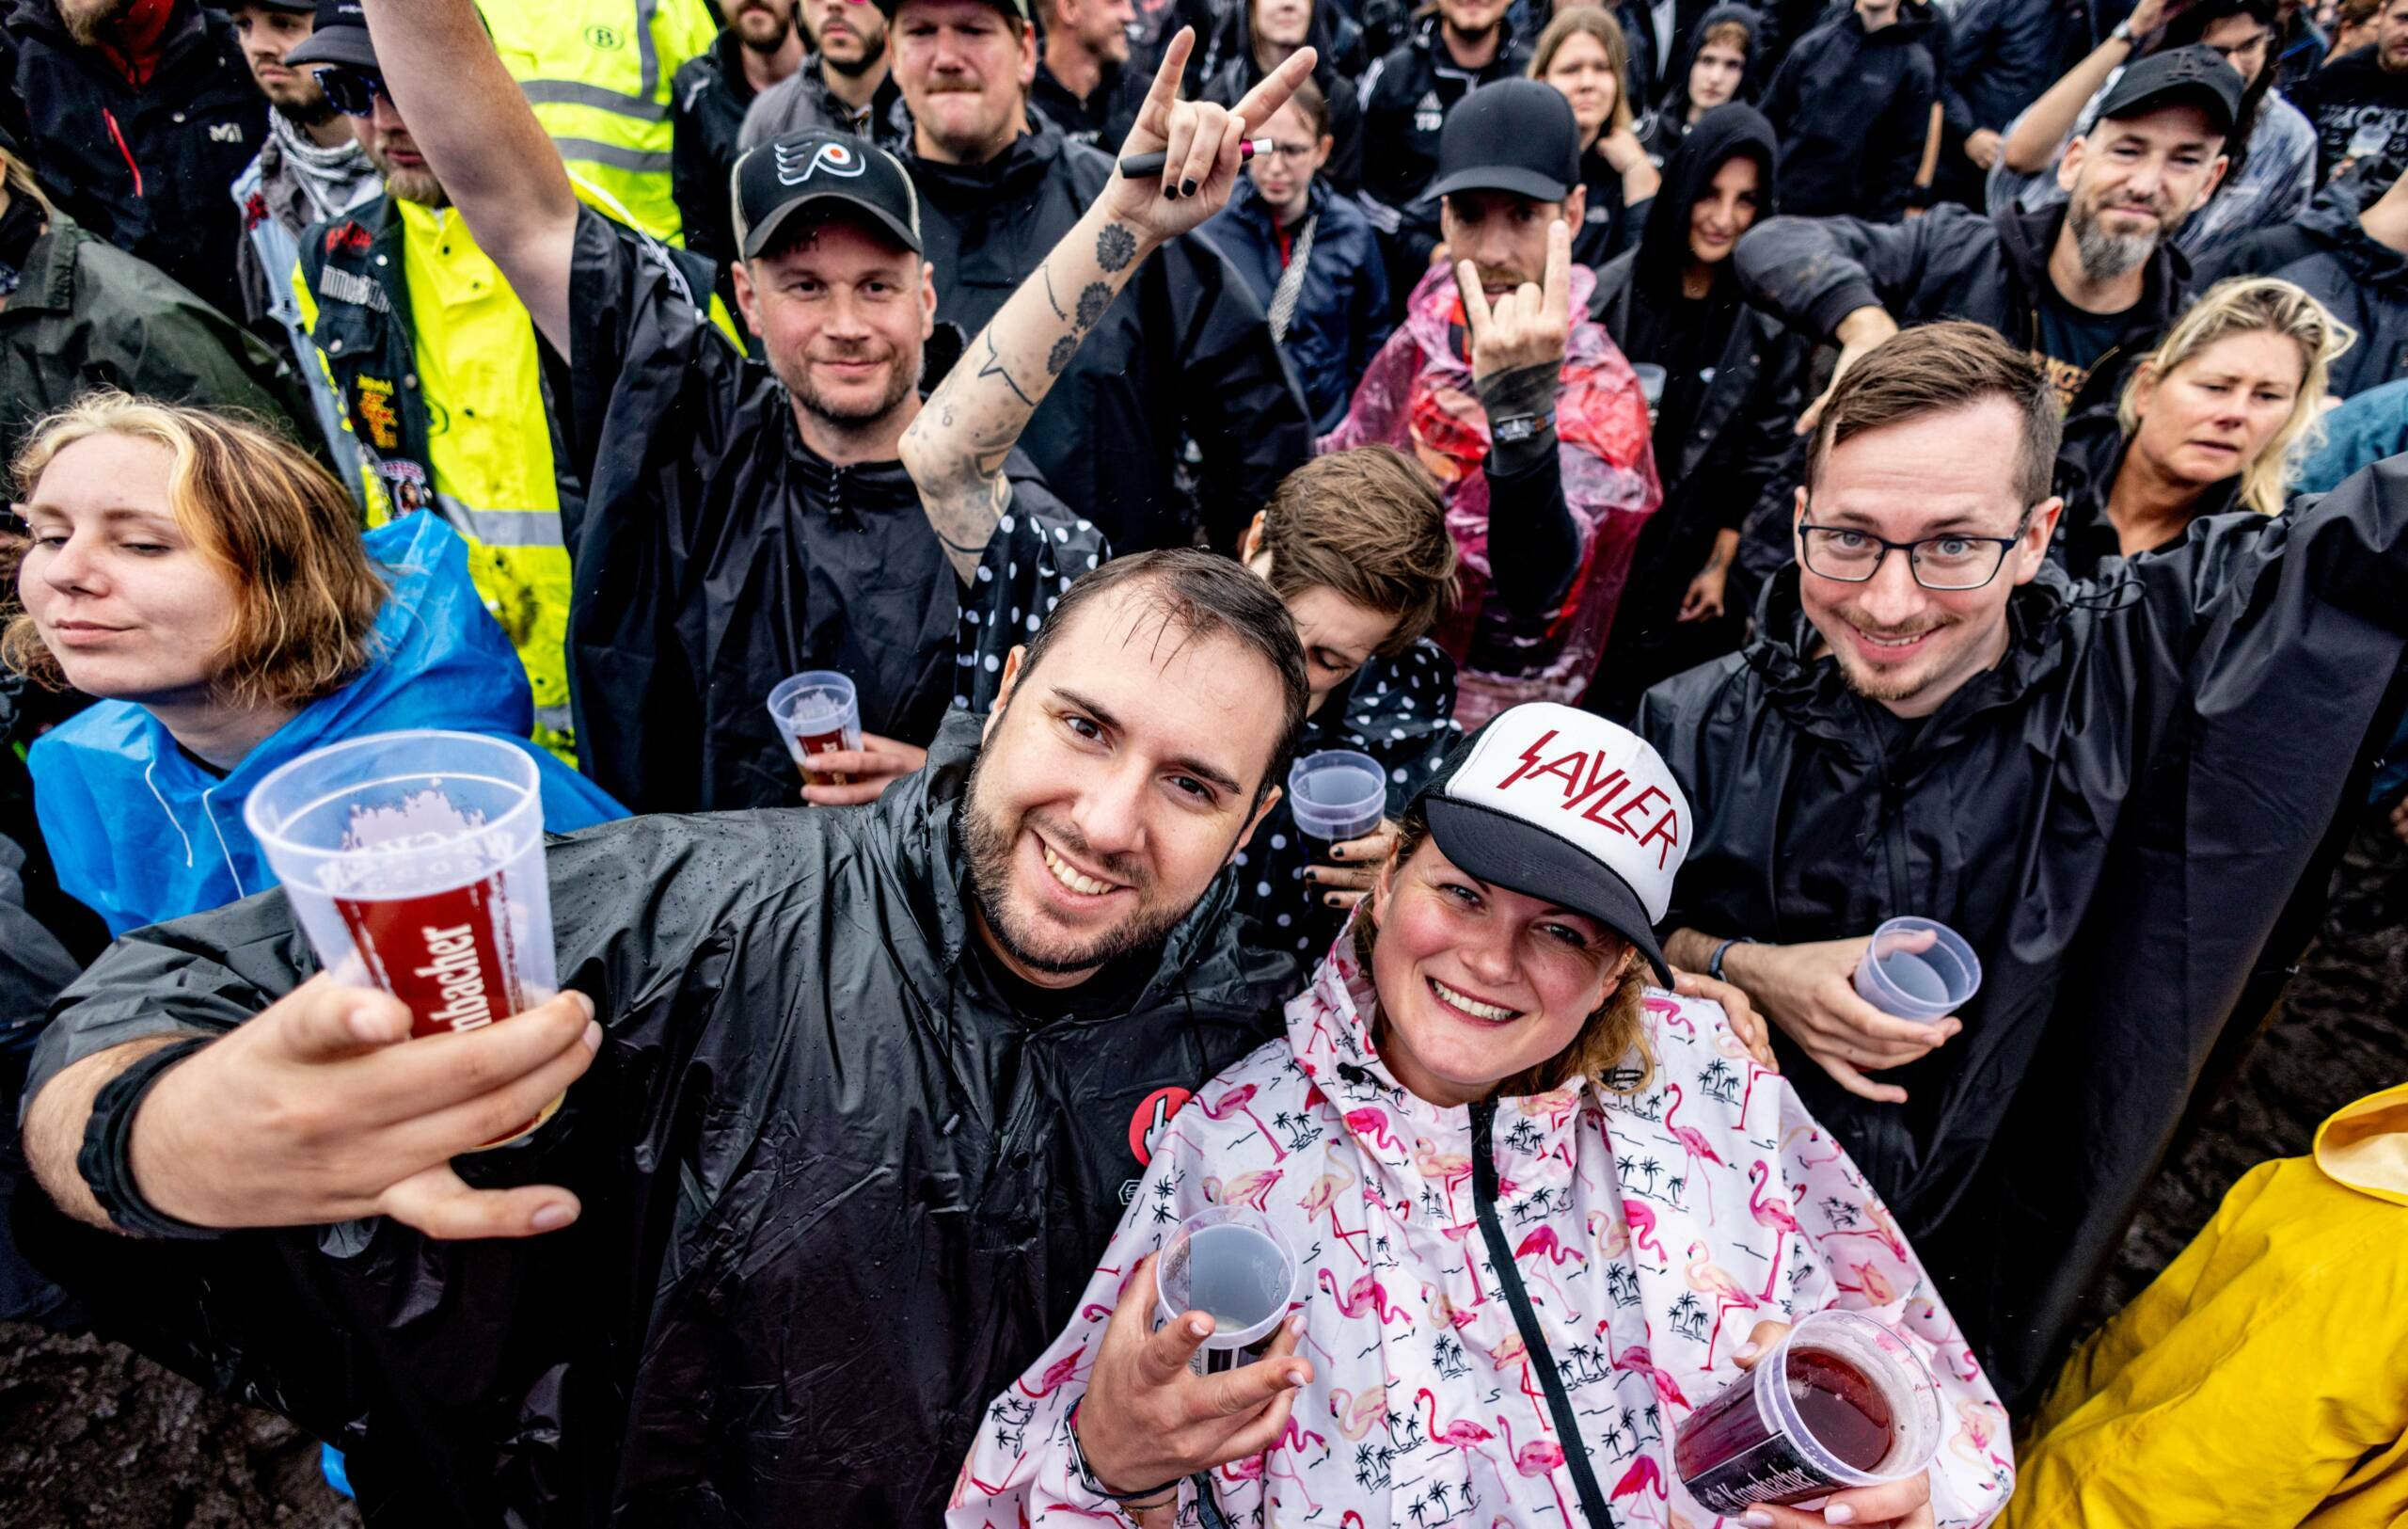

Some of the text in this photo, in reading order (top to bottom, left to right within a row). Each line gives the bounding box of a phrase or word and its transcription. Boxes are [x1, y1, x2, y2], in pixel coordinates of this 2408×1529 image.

[1496, 729, 1678, 871] SAYLER
[414, 923, 493, 1033] mbacher
[1717, 1462, 1821, 1507] Krombacher
